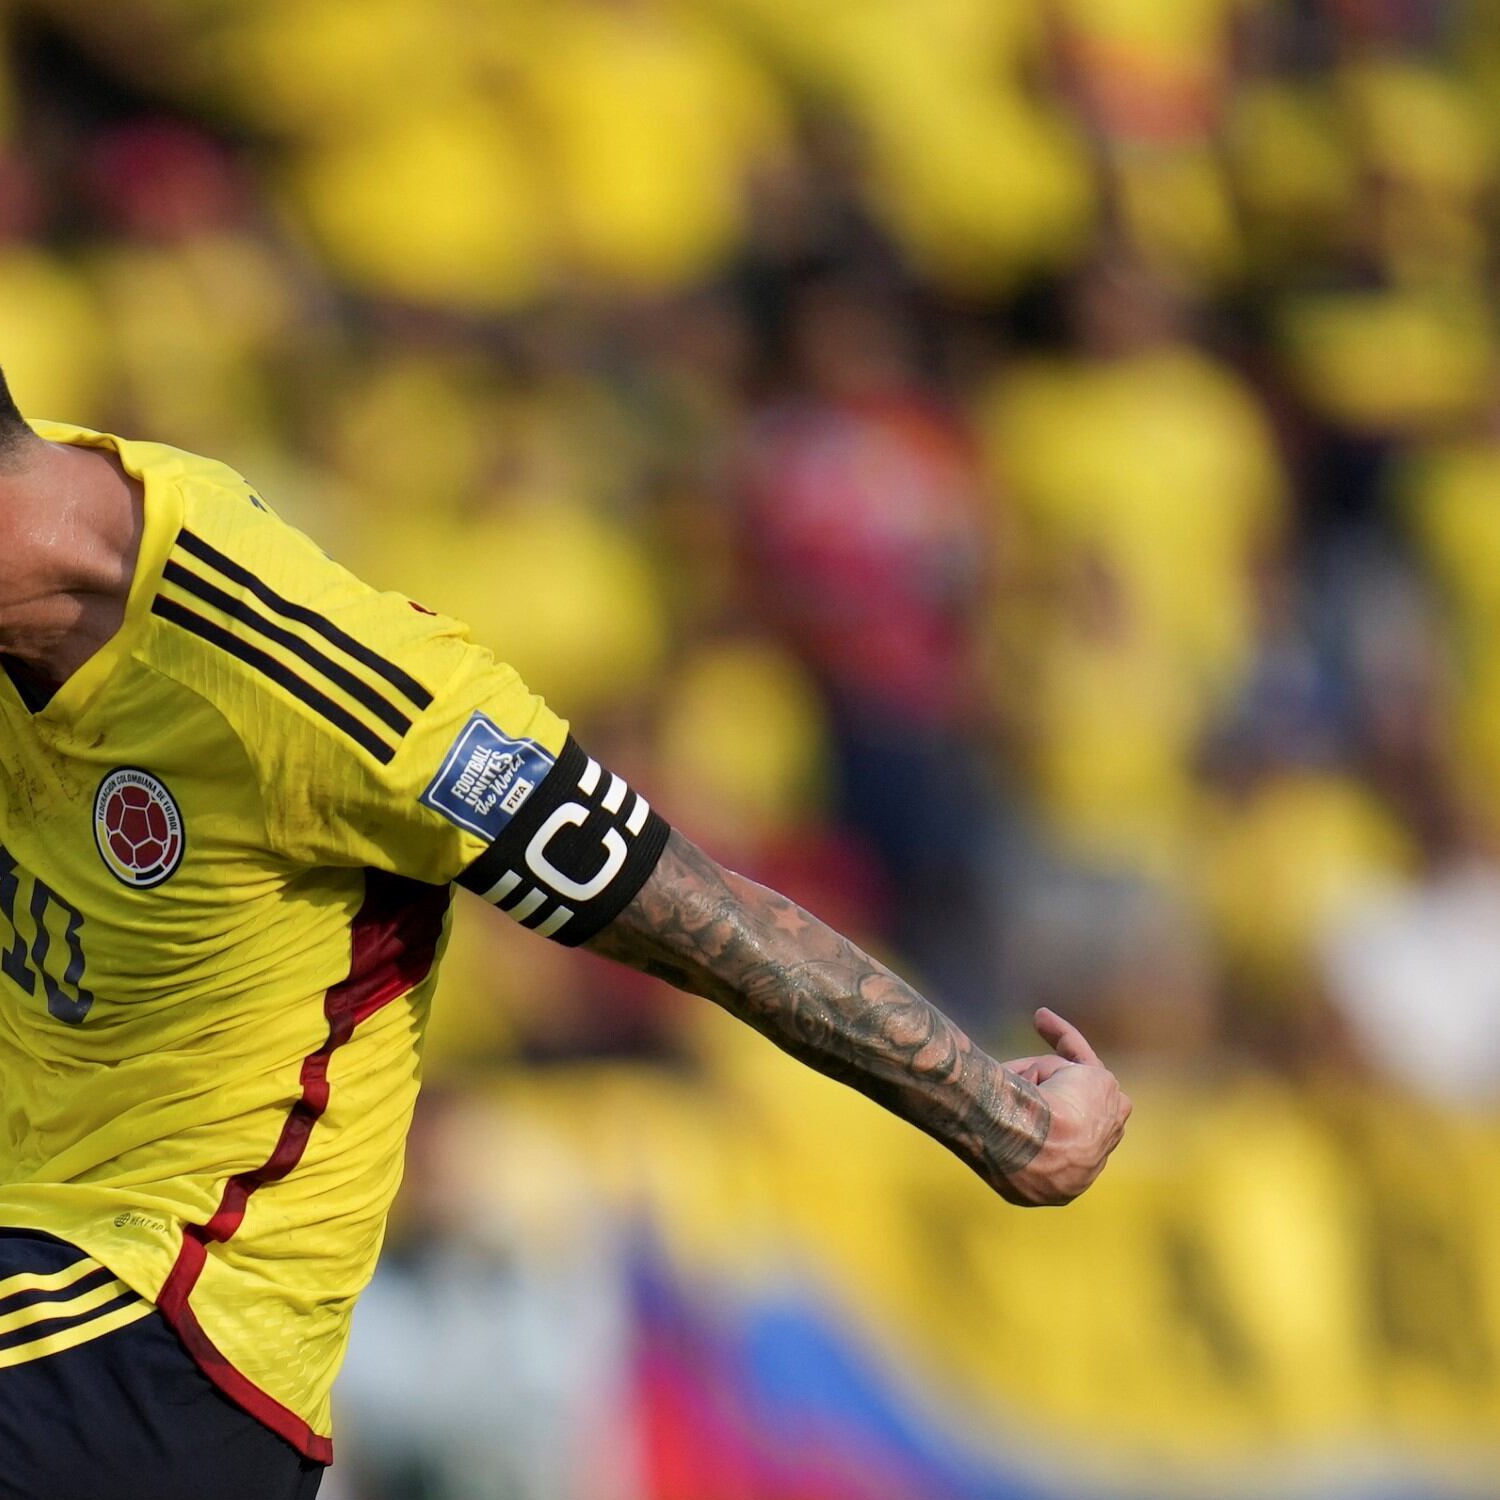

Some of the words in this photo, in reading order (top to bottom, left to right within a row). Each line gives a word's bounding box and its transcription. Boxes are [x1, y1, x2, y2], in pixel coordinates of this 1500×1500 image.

[116, 773, 158, 794] COLOMBIANA
[156, 790, 168, 804] DE
[451, 745, 492, 800] FOOTBALL
[463, 750, 514, 807] UNITES
[506, 785, 528, 810] FIFA
[525, 801, 628, 902] C
